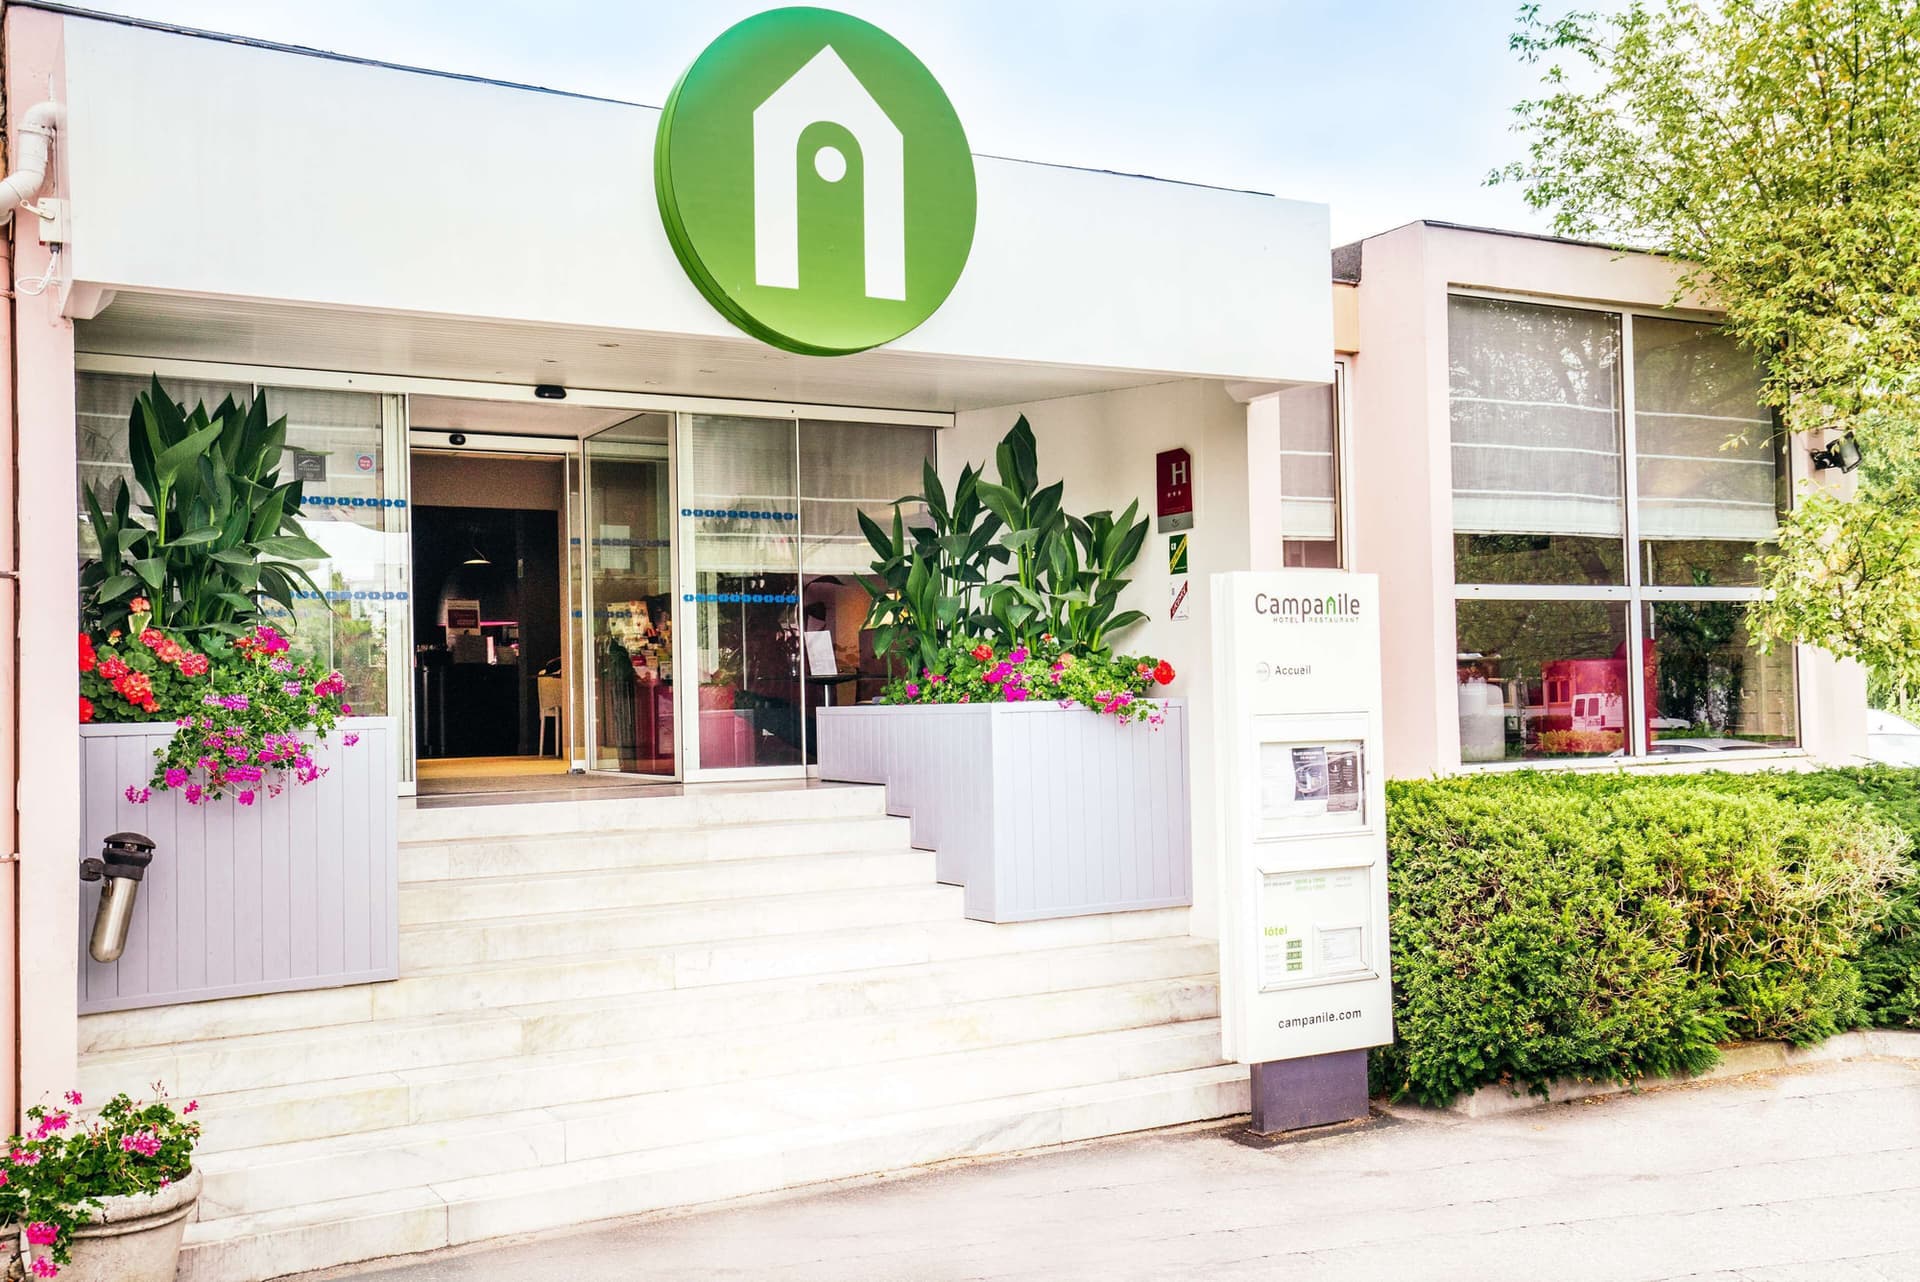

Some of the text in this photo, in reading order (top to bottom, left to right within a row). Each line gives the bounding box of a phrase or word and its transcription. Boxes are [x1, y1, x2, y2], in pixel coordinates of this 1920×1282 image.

[1171, 461, 1187, 486] H
[1255, 593, 1360, 622] Campanile
[1275, 665, 1311, 675] Accueil
[1278, 1009, 1362, 1028] campanile.com
